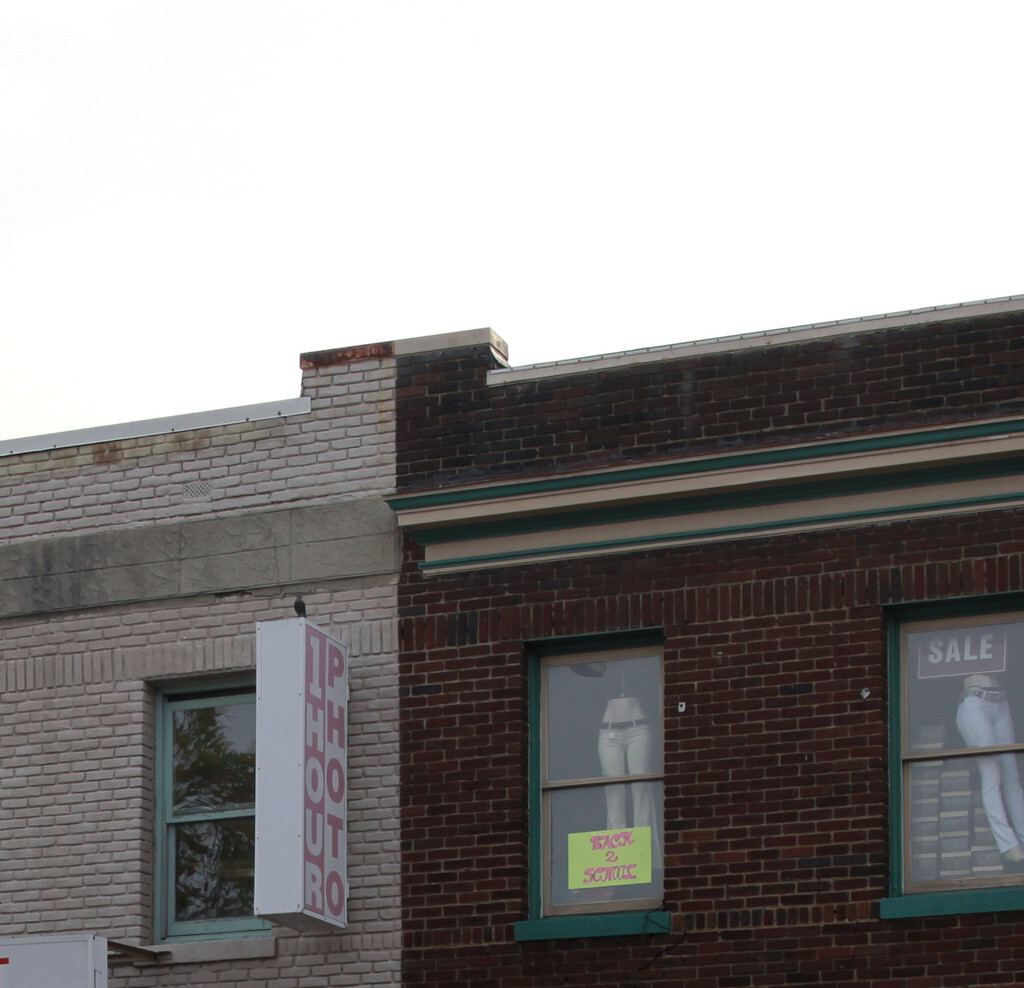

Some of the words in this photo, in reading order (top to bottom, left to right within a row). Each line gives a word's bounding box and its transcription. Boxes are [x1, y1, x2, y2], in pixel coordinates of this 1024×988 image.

[928, 634, 993, 664] SALE
[326, 645, 346, 918] PHOTO
[590, 831, 635, 850] BACK
[605, 850, 619, 863] 2
